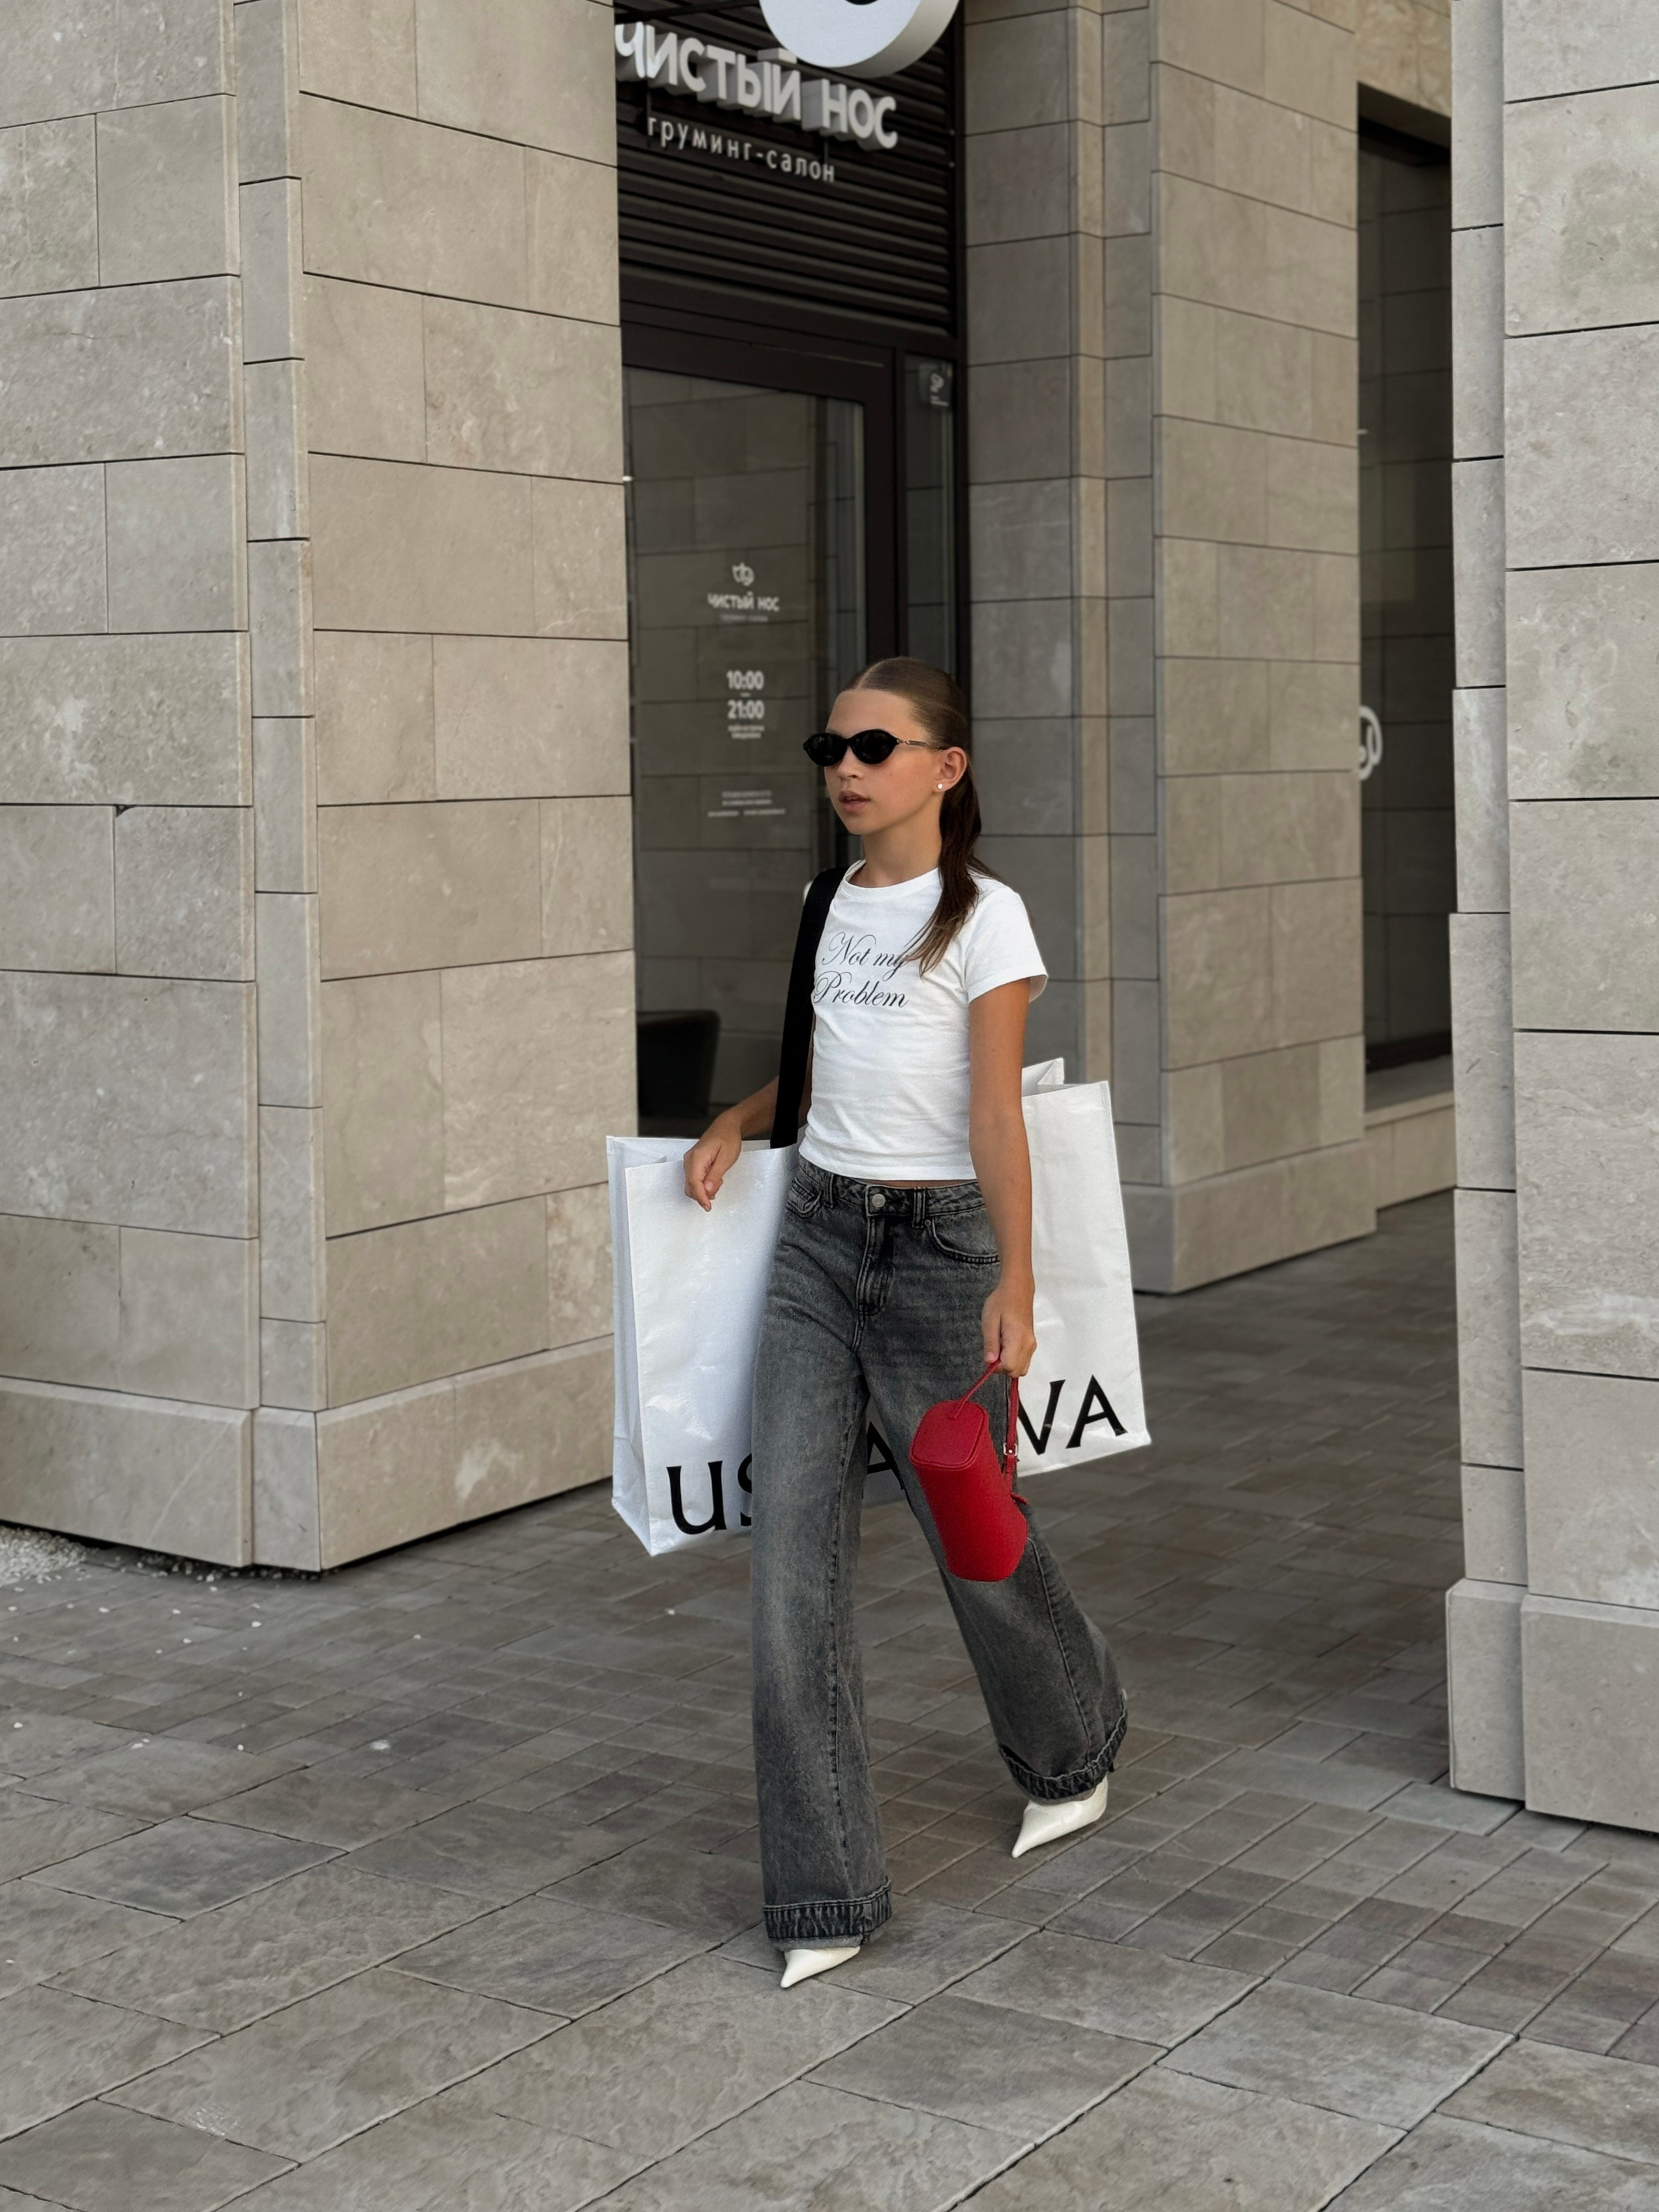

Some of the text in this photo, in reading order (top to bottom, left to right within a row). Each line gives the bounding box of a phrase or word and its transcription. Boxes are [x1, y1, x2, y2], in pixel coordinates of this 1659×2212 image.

[614, 21, 898, 150] ЧИСТЫЙ НОС
[648, 117, 835, 183] груминг-салон
[757, 596, 780, 612] НОС
[726, 670, 765, 690] 10:00
[727, 699, 765, 719] 21:00
[821, 931, 877, 966] Not
[813, 970, 909, 1008] Problem
